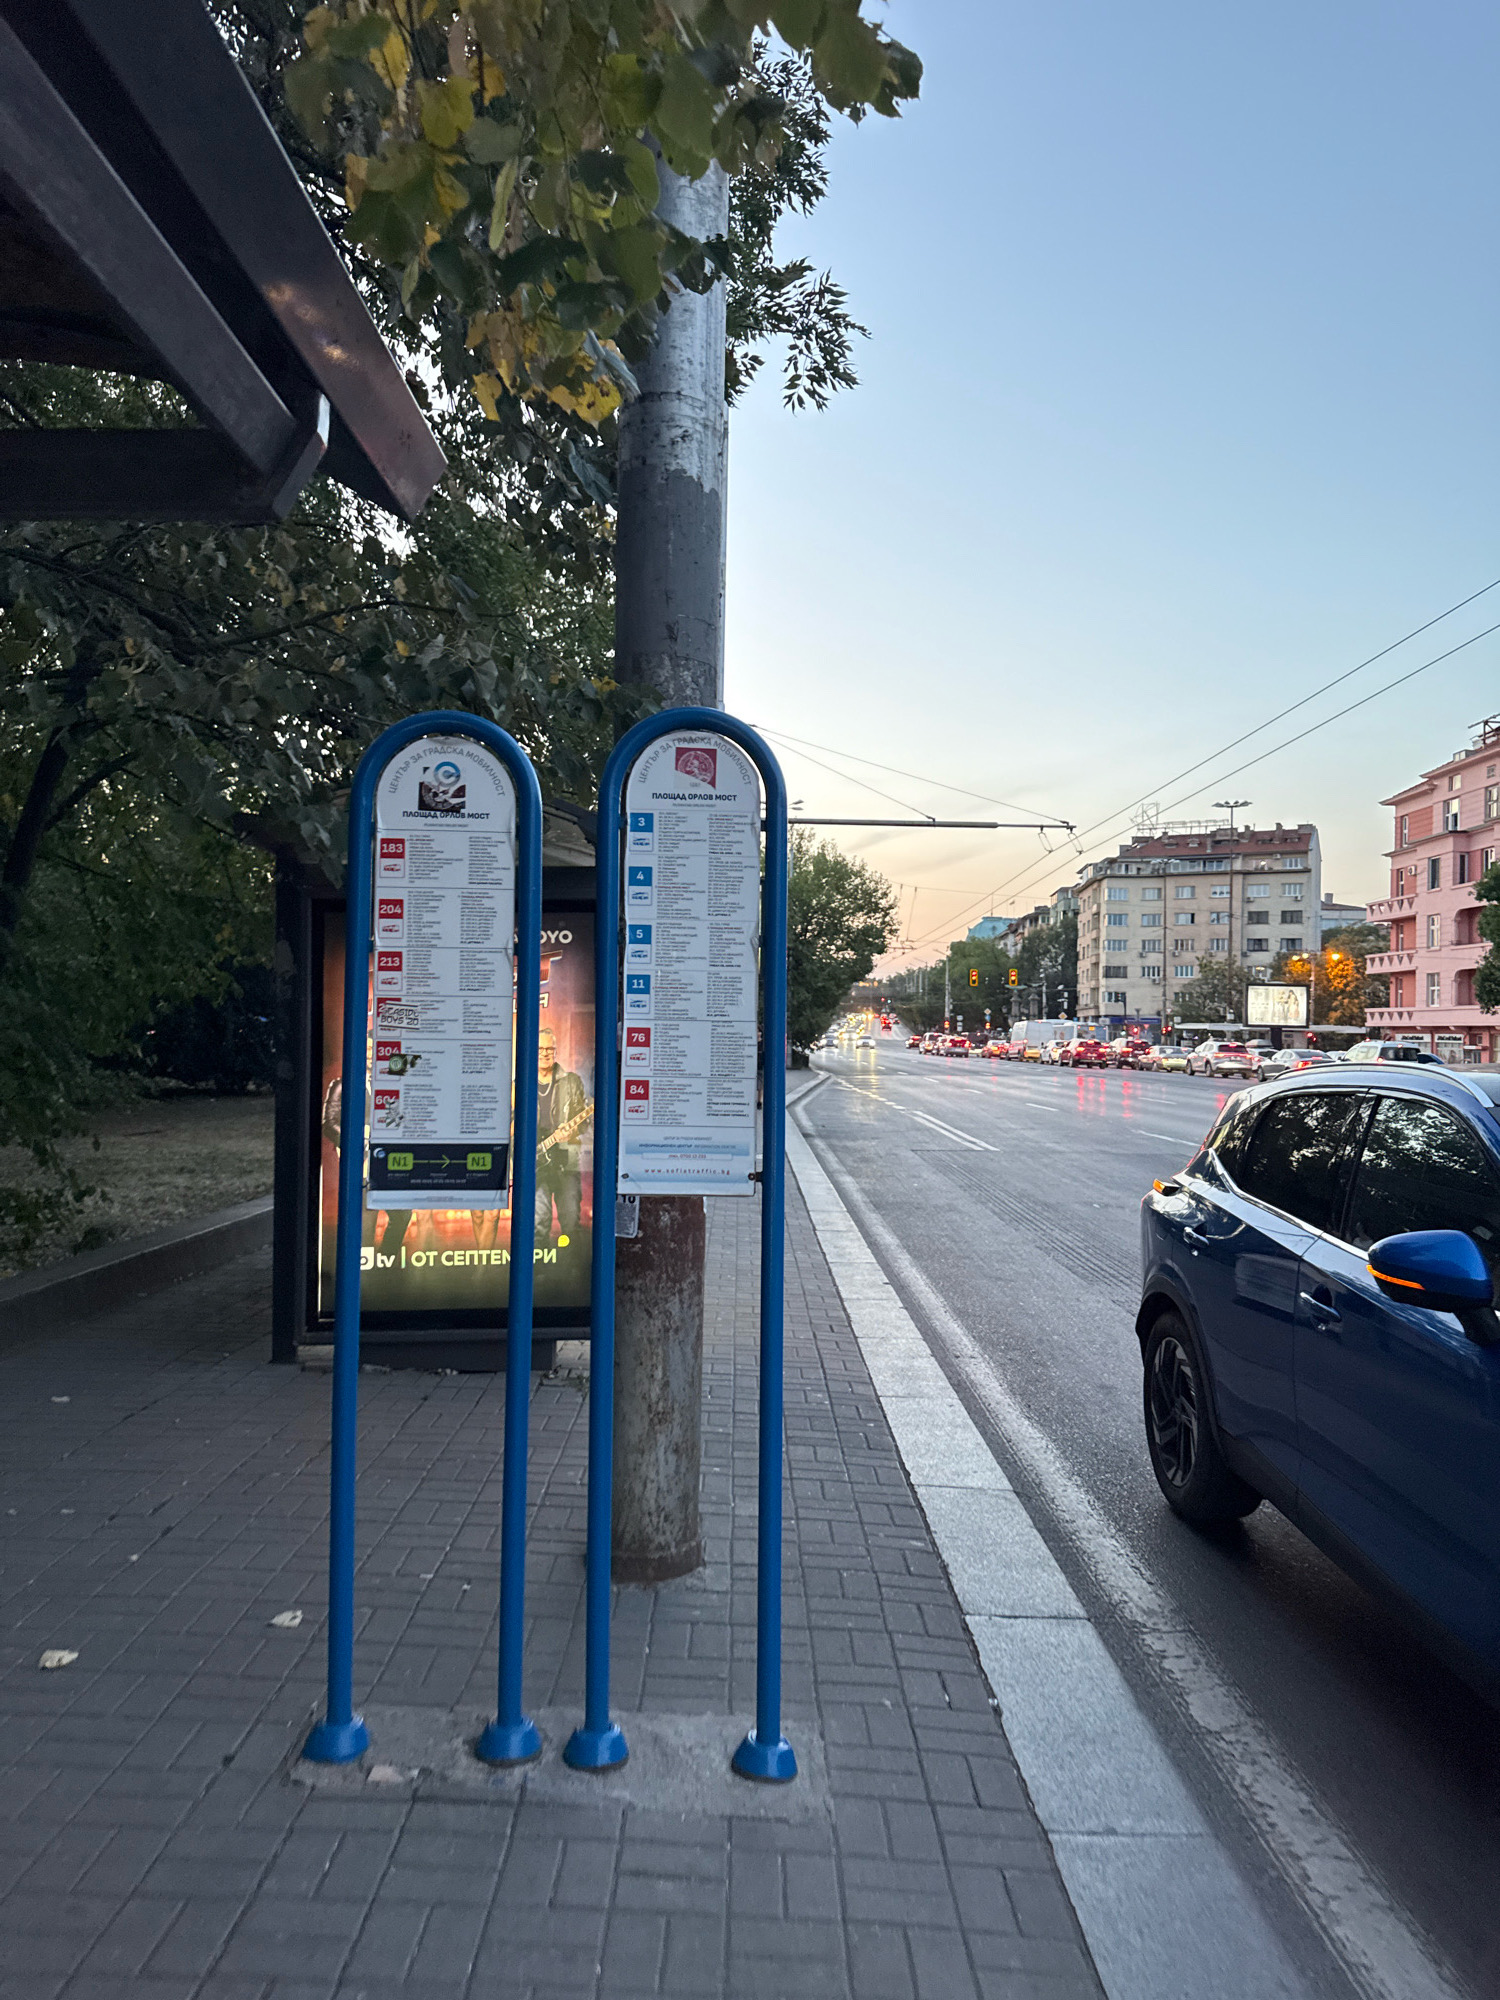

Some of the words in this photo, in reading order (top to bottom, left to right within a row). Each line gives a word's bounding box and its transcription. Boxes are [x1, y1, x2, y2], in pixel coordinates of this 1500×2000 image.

[638, 750, 660, 783] ЦЕНТЪР
[660, 743, 673, 753] ЗА
[672, 736, 712, 746] ГРАДСКА
[713, 740, 752, 786] МОБИЛНОСТ
[388, 760, 411, 794] ЦЕНТЪР
[410, 752, 423, 764] ЗА
[423, 746, 464, 757] ГРАДСКА
[465, 750, 505, 797] МОБИЛНОСТ
[652, 792, 687, 801] ПЛОЩАД
[688, 792, 713, 801] ОРЛОВ
[402, 810, 438, 819] ПЛОЩАД
[439, 811, 466, 819] ОРЛОВ
[637, 817, 646, 827] 3
[381, 843, 404, 853] 183
[636, 871, 644, 880] 4
[379, 904, 402, 914] 204
[635, 929, 644, 939] 5
[379, 957, 400, 967] 213
[631, 979, 645, 989] 11
[380, 1014, 404, 1025] BOYS
[631, 1033, 646, 1042] 76
[378, 1047, 400, 1056] 304
[629, 1085, 645, 1094] 84
[392, 1157, 409, 1167] N1
[471, 1156, 488, 1167] N1
[411, 1251, 437, 1267] ОТ
[441, 1248, 557, 1267] СЕПТЕМРИ
